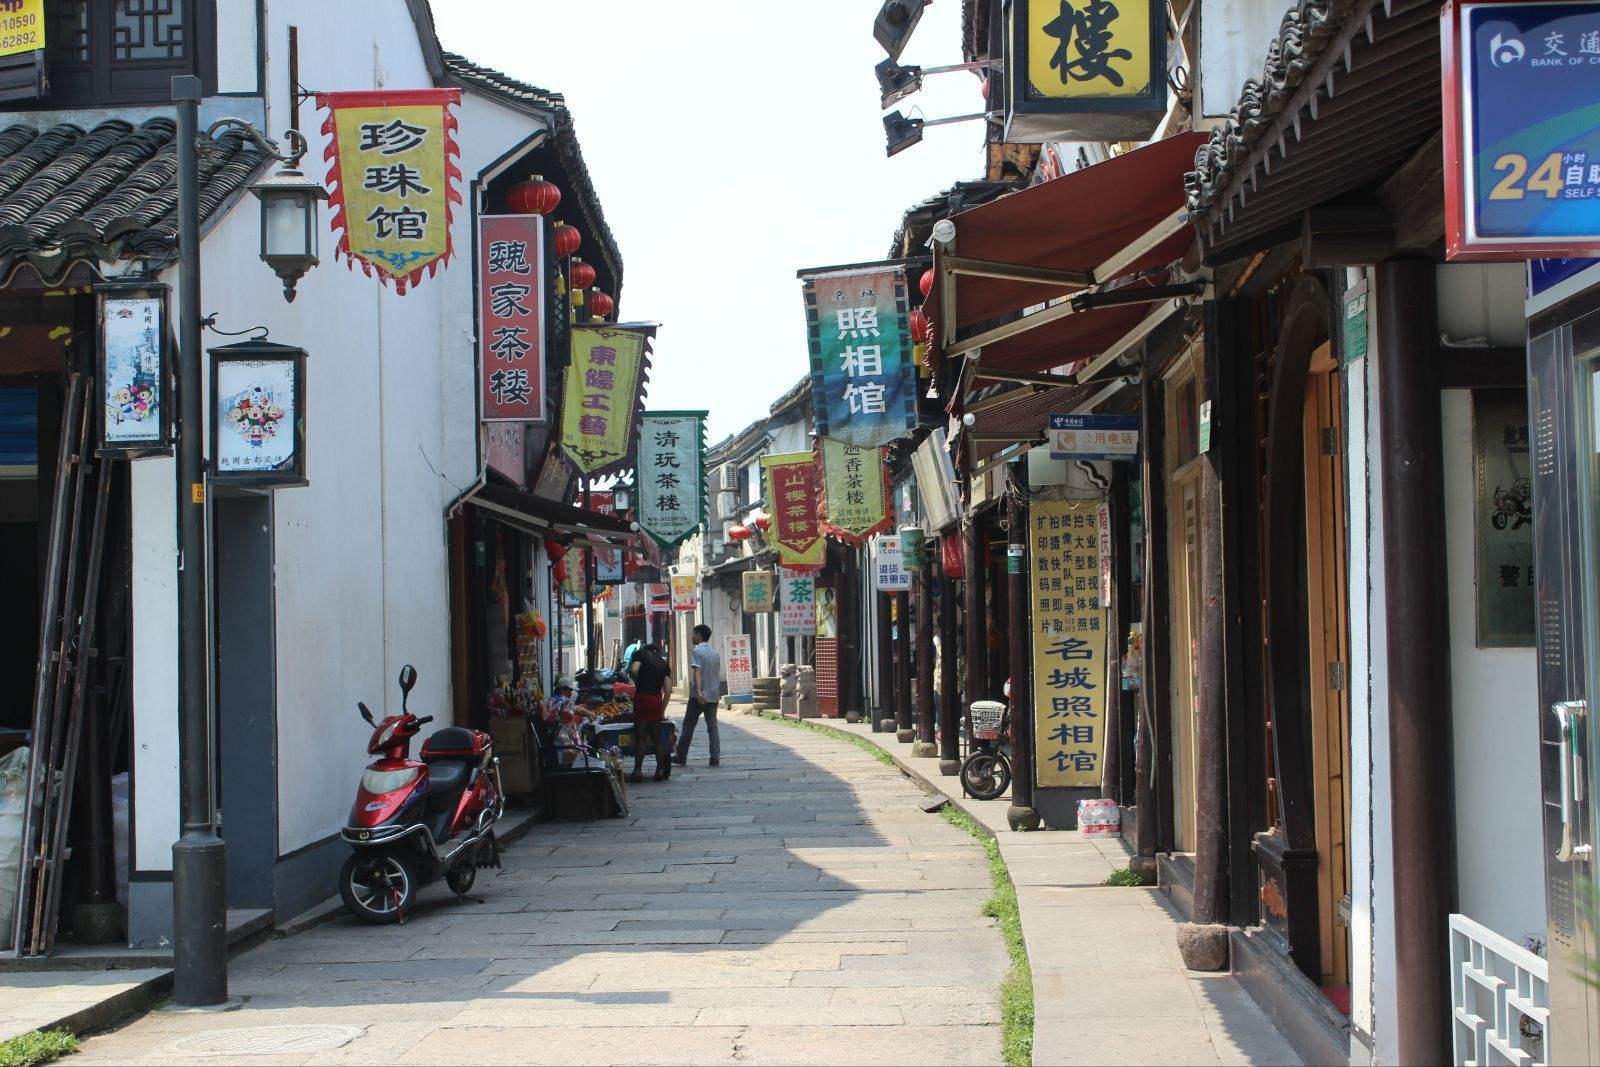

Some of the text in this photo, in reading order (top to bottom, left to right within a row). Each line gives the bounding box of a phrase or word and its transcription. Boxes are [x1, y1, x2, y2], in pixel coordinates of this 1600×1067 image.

[0, 31, 36, 49] 62892
[1531, 56, 1600, 67] BANK OF C
[359, 118, 432, 241] 珍珠馆
[1489, 153, 1564, 200] 24
[1563, 153, 1585, 164] 小时
[1565, 188, 1594, 198] SELF
[488, 240, 533, 406] 魏家茶楼
[836, 306, 887, 416] 照相馆
[653, 430, 681, 512] 清玩茶楼
[1080, 432, 1134, 445] 公用电话
[789, 579, 812, 603] 茶
[1036, 514, 1051, 634] 扩印数码照片
[1074, 514, 1088, 632] 拍大型团体照
[1085, 514, 1100, 632] 专业影视编辑
[1045, 637, 1098, 772] 名城照相馆
